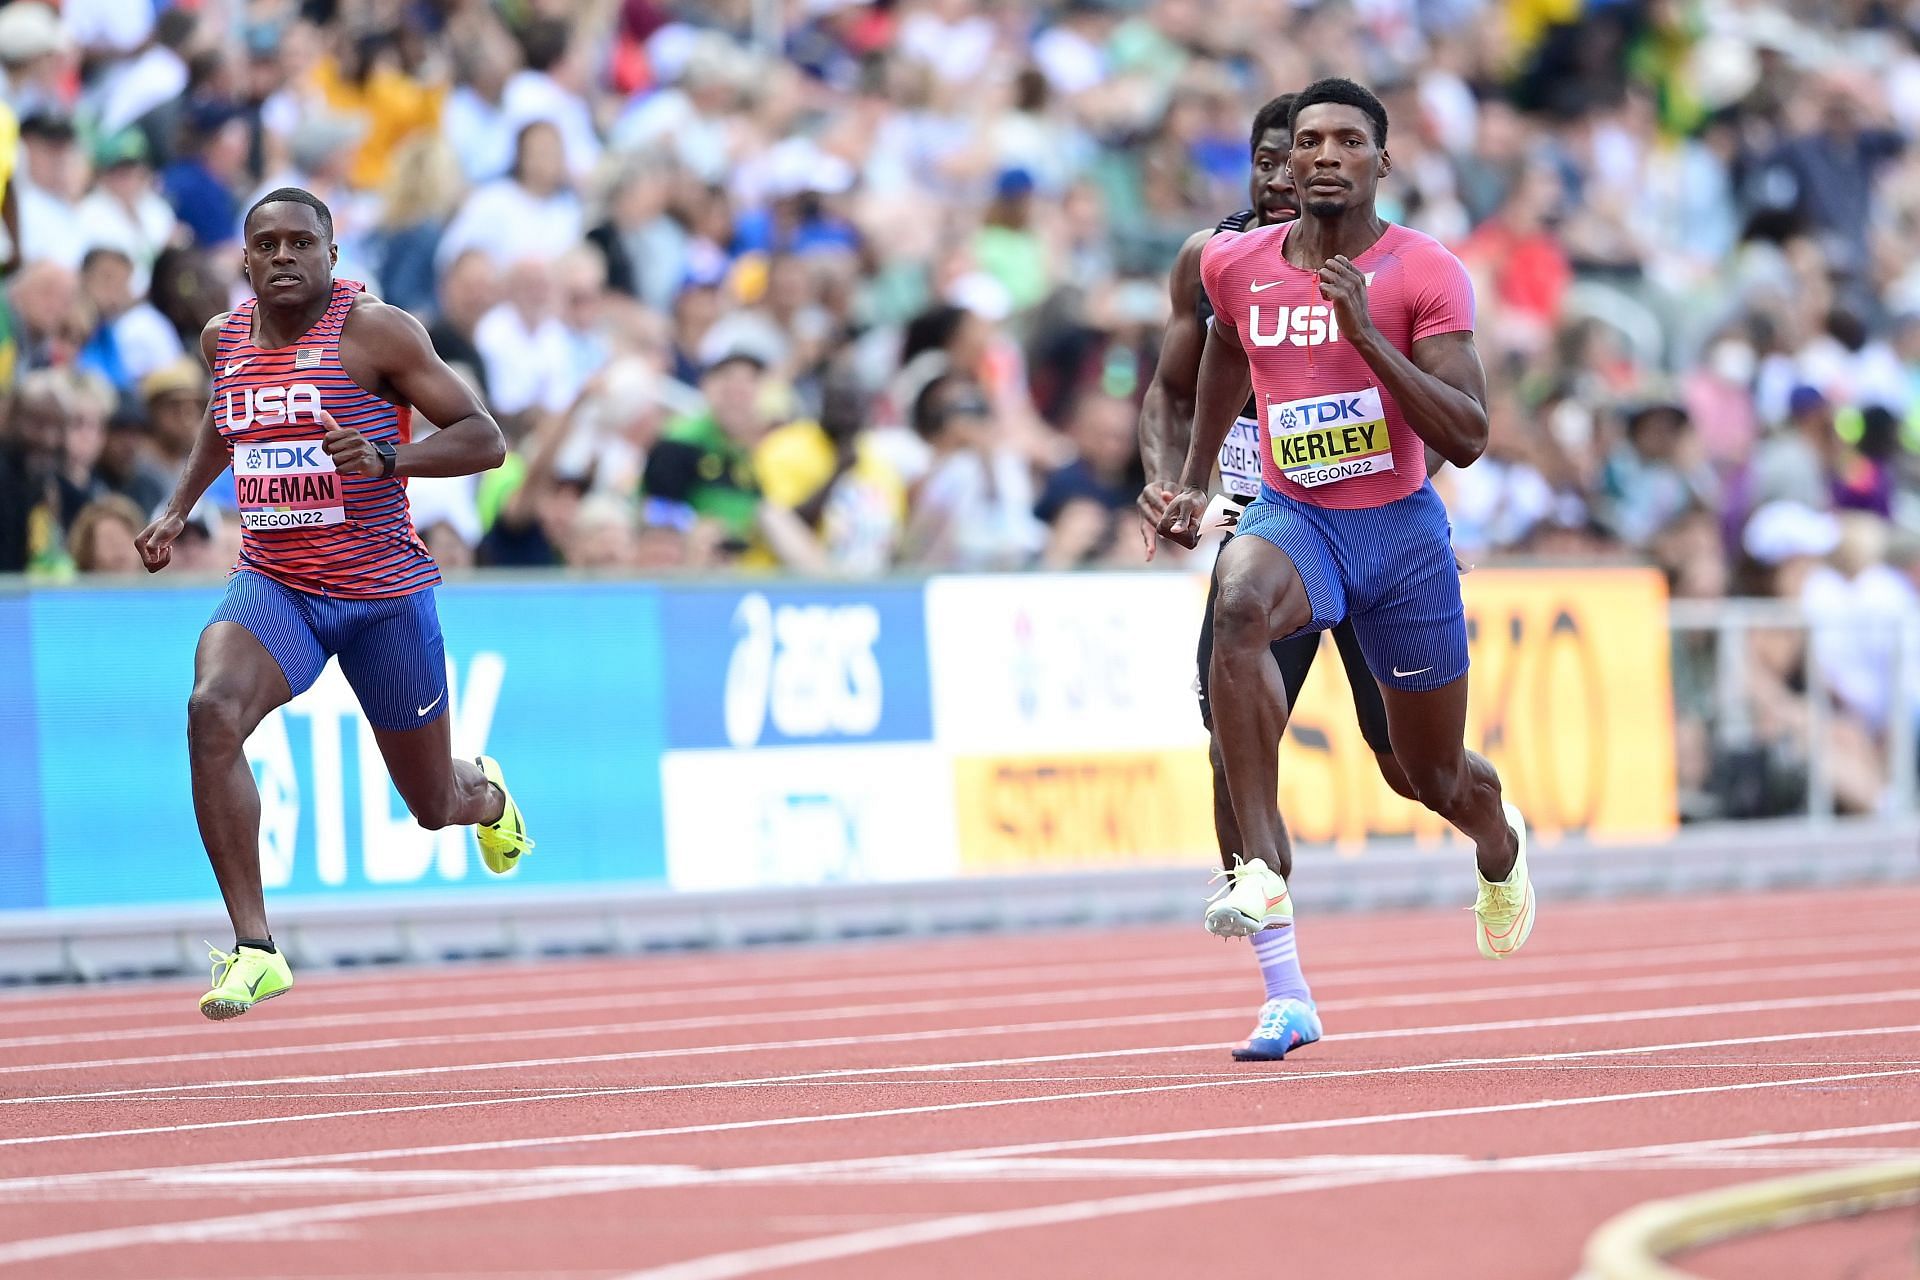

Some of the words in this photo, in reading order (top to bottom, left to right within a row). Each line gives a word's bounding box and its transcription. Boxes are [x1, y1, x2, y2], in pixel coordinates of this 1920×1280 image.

[226, 384, 322, 431] USA
[1296, 398, 1365, 426] TDK
[261, 446, 320, 469] TDK
[1281, 425, 1375, 465] KERLEY
[1291, 461, 1372, 486] OREGON22
[238, 475, 335, 505] COLEMAN
